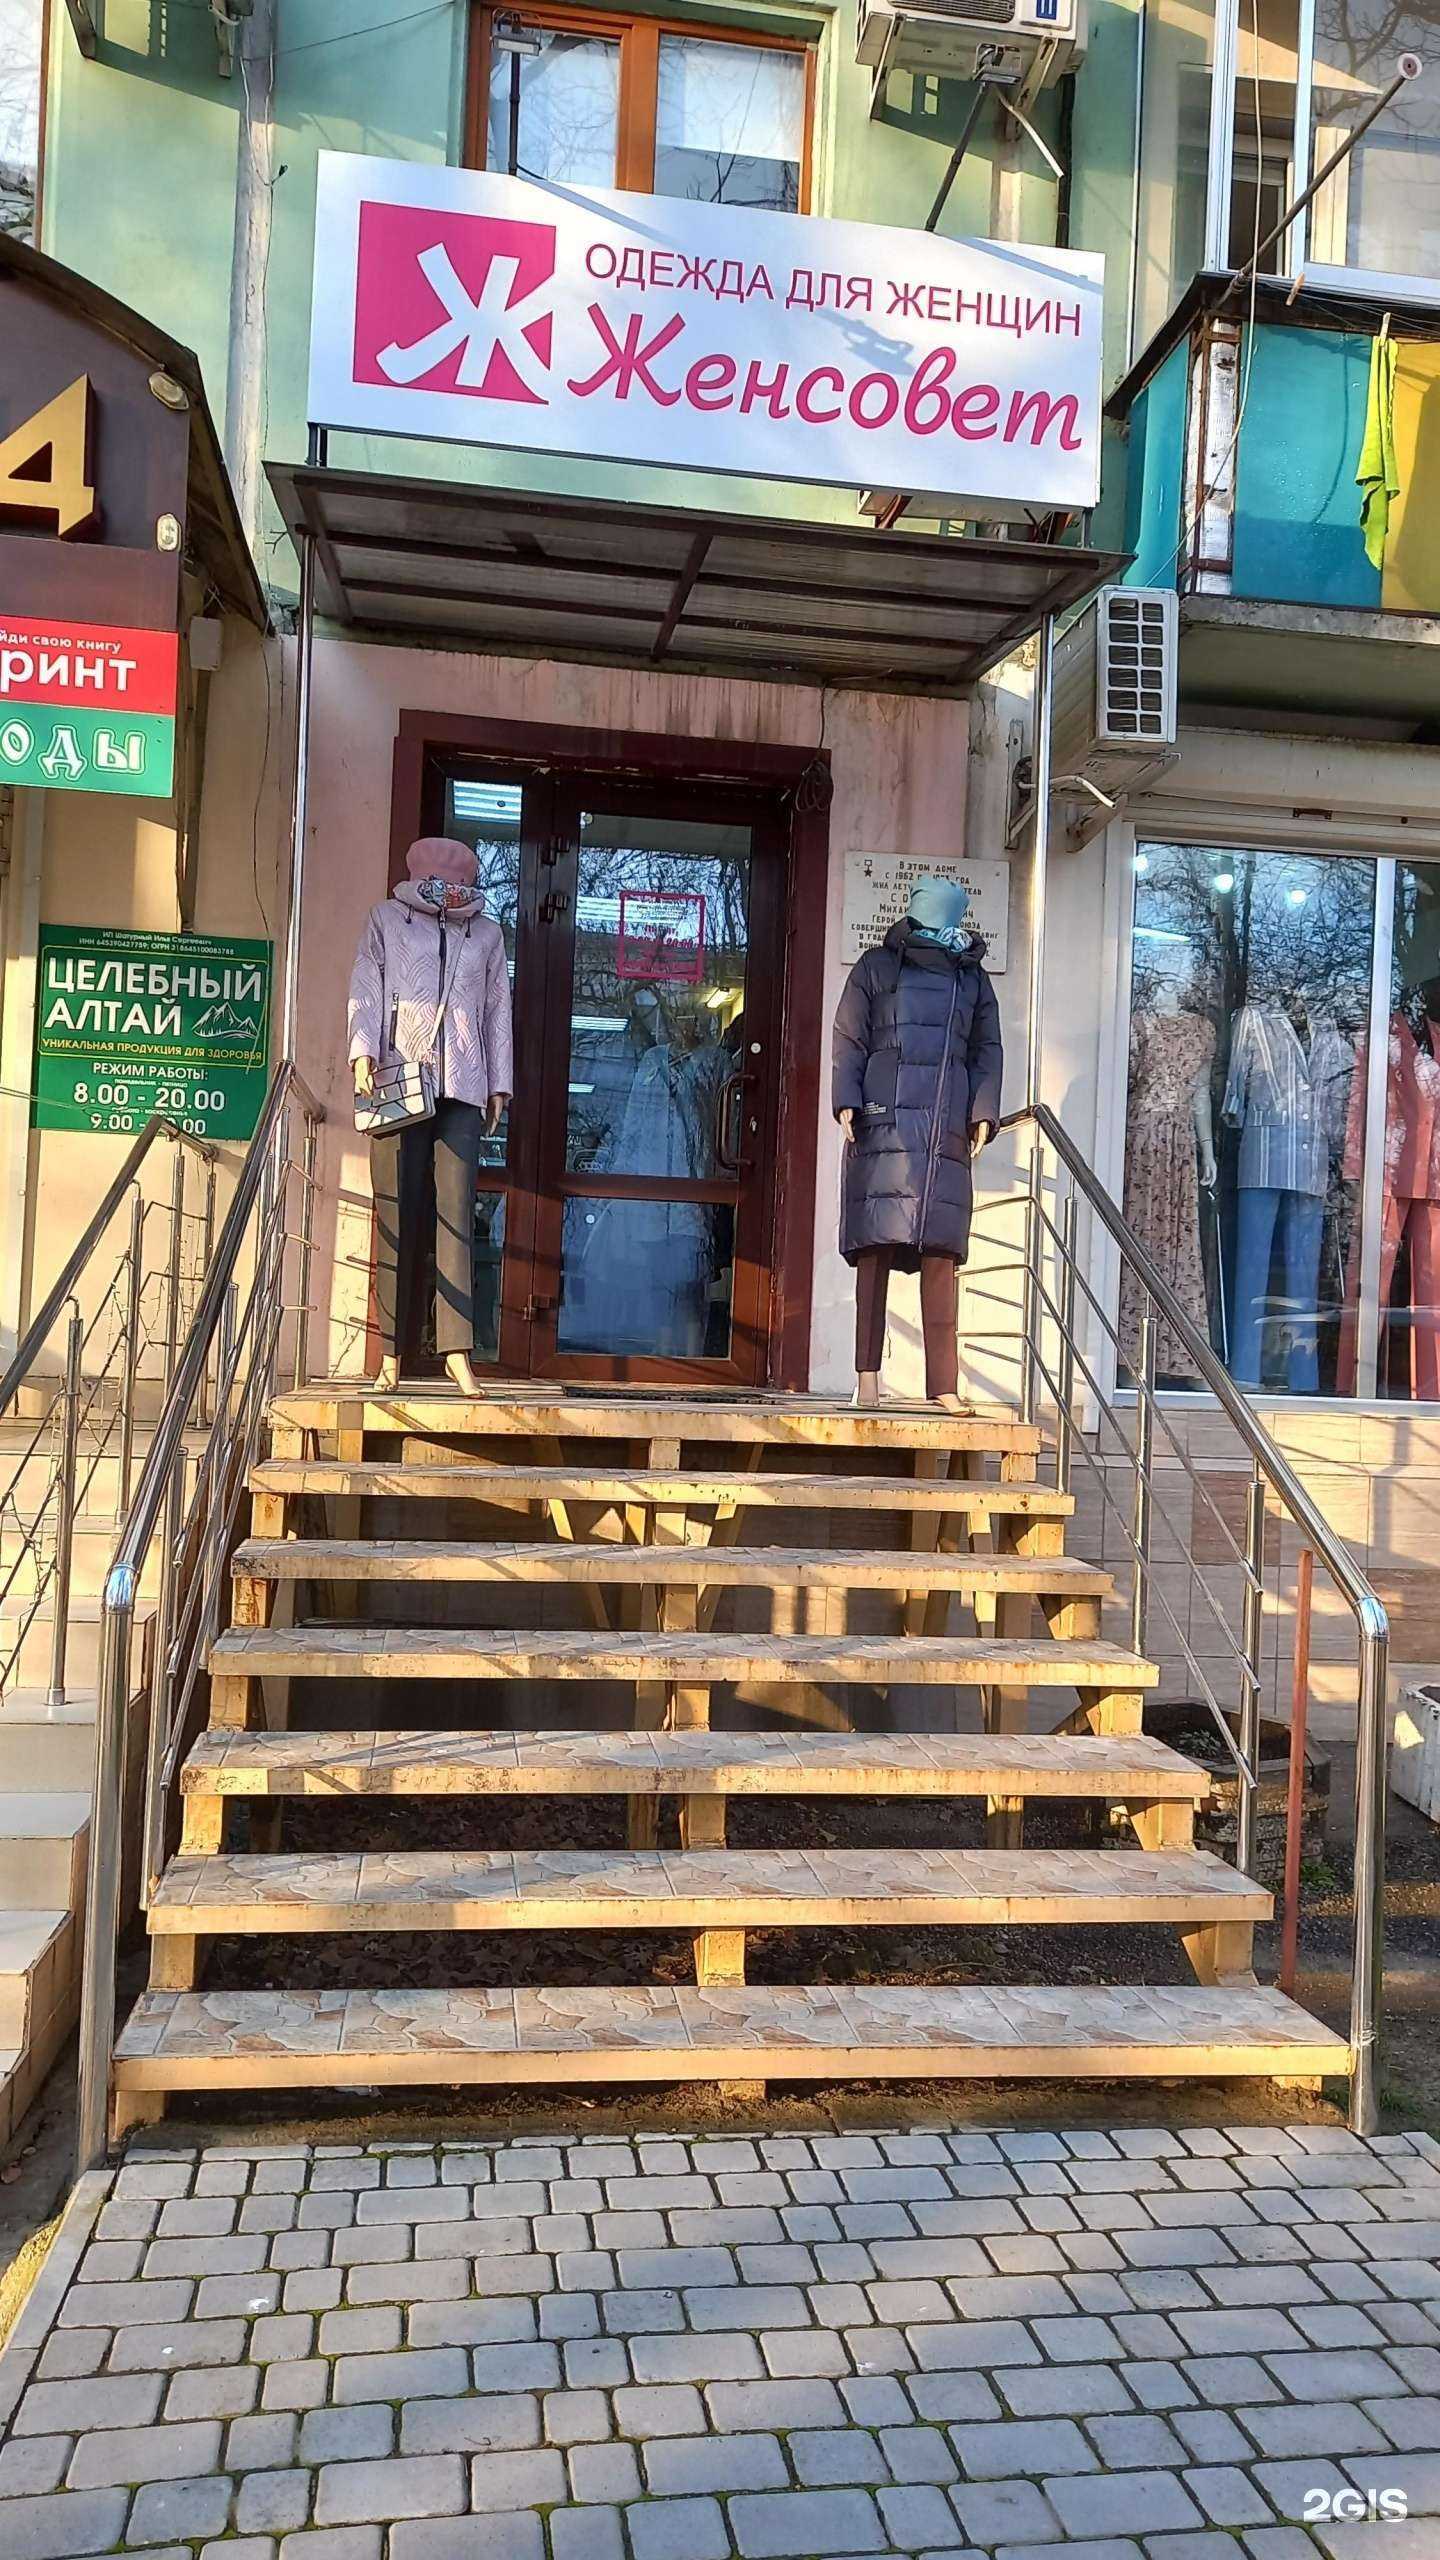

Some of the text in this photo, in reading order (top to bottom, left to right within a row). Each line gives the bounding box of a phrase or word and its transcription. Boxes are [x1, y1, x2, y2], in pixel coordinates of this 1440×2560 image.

[586, 243, 1082, 339] ОДЕЖДА ДЛЯ ЖЕНЩИН
[567, 303, 1082, 451] Женсовет
[0, 629, 122, 655] йди свою книгу
[0, 649, 137, 694] ринт
[0, 718, 146, 782] оды
[895, 871, 913, 881] 1962
[907, 863, 930, 872] ЭТОМ
[935, 865, 958, 873] ДОМЕ
[851, 923, 890, 932] СОВЕРШИ
[959, 921, 981, 930] ОЮЗА
[48, 957, 262, 1002] ЦЕЛЕБНЫЙ
[44, 997, 182, 1036] АЛТАЙ
[42, 1038, 263, 1061] УНИКАЛЬНАЯ ПРОДУКЦИЯ ДЛЯ ЗДОРОВЬЯ
[92, 1062, 209, 1081] РЕЖИМ РАБОТЫ:
[73, 1082, 129, 1106] 8.00
[154, 1087, 226, 1112] 20.00
[90, 1113, 133, 1131] 9.00
